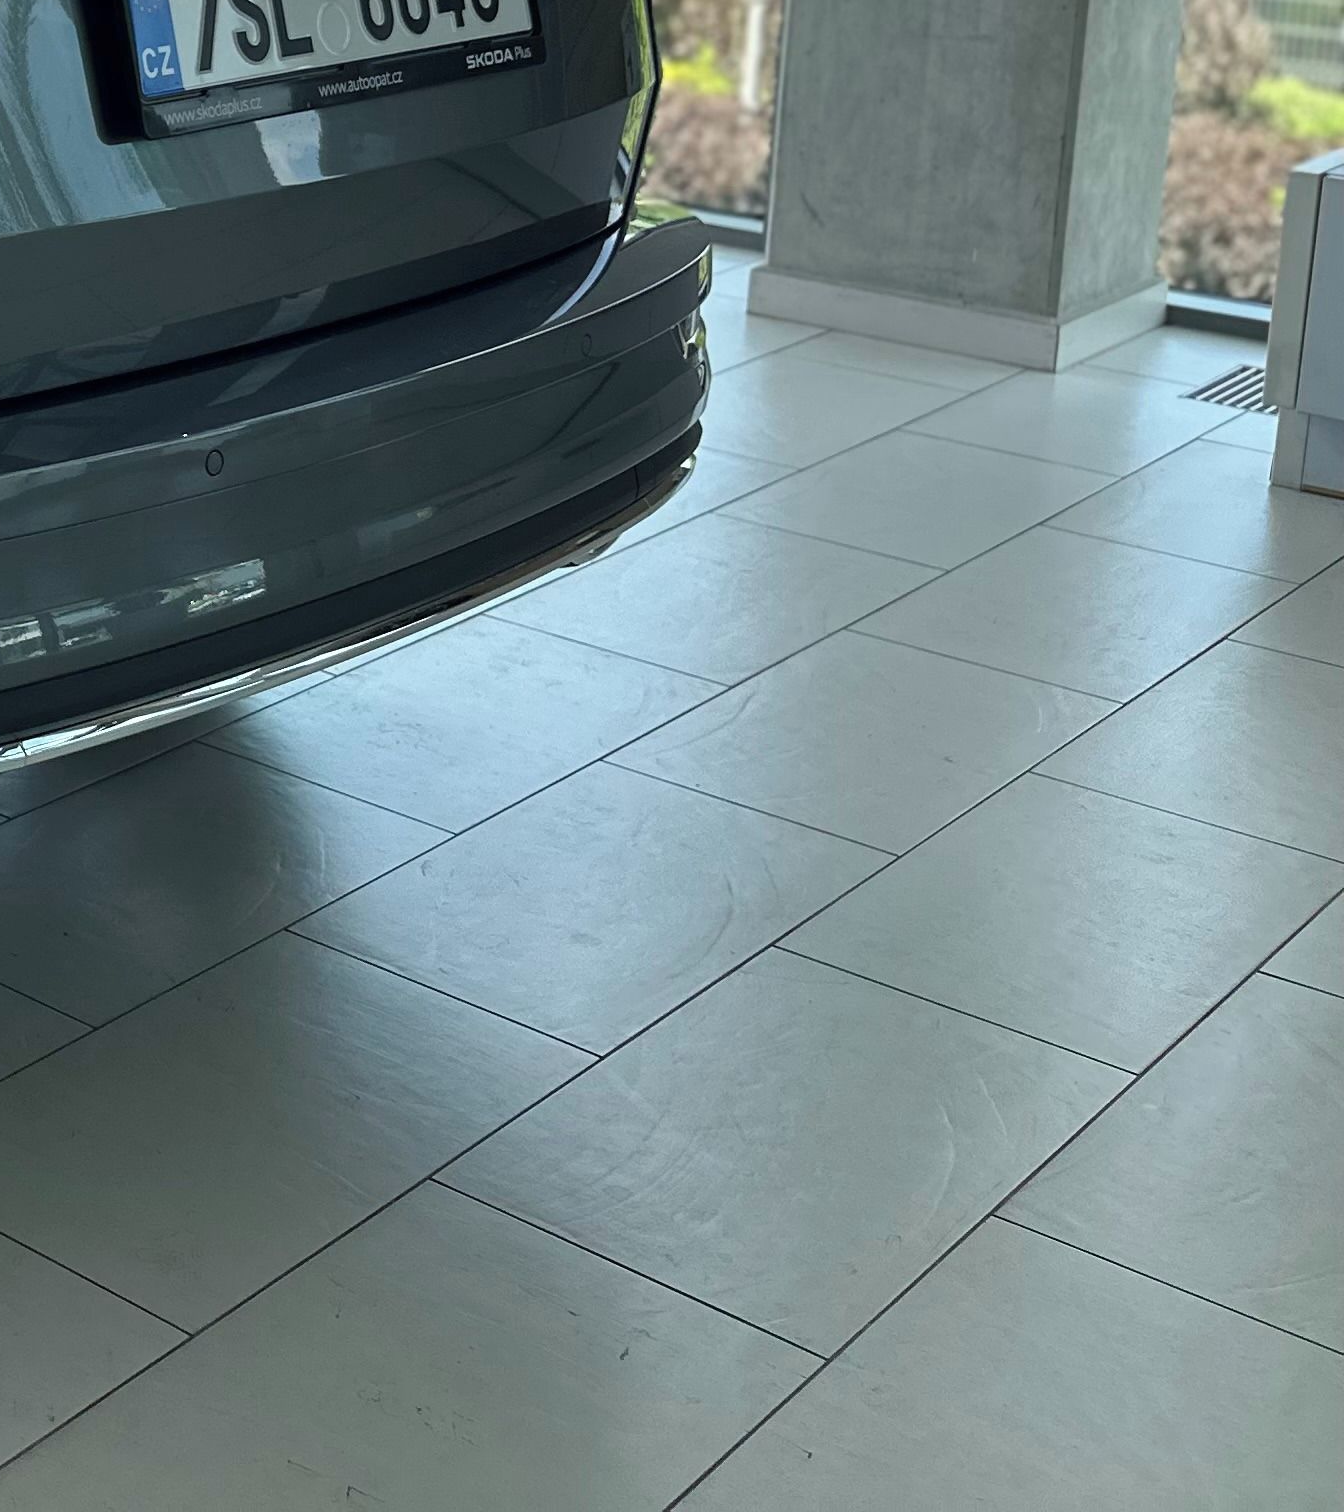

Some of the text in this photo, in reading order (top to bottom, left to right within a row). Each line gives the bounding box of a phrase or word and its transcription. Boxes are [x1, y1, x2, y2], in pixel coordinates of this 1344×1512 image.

[142, 45, 175, 79] CZ
[317, 70, 404, 97] www.autoopat.cz
[163, 96, 263, 126] www.skodaplus.cz
